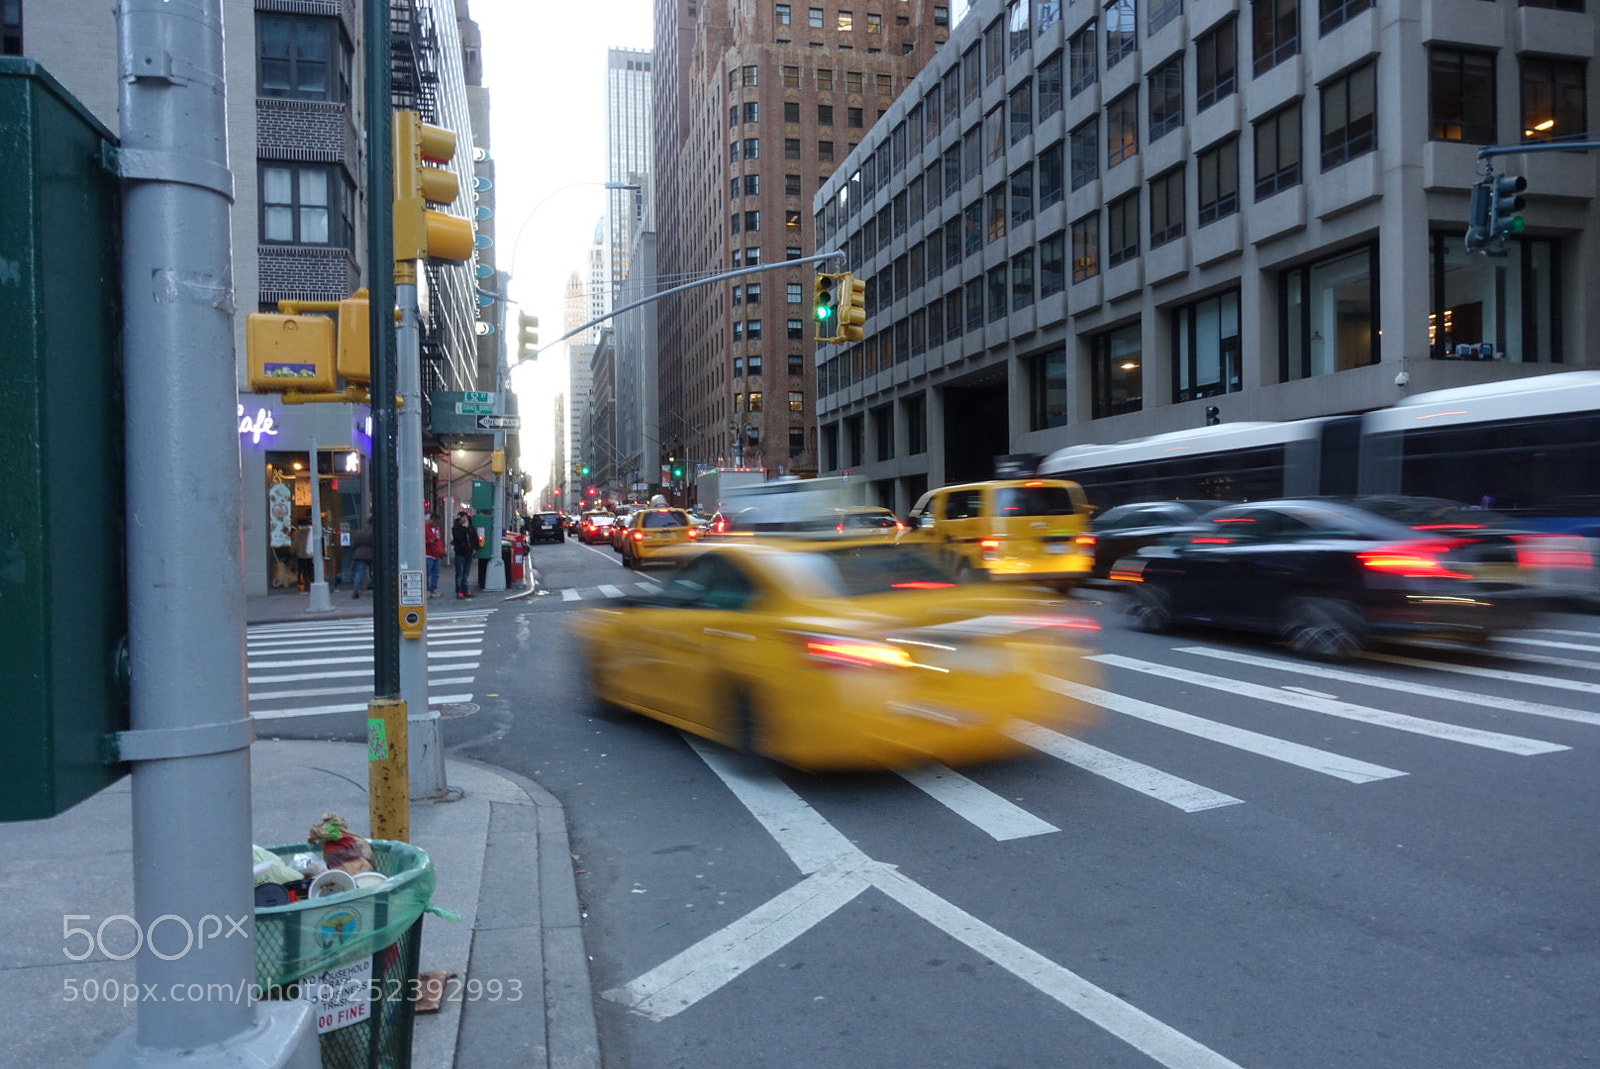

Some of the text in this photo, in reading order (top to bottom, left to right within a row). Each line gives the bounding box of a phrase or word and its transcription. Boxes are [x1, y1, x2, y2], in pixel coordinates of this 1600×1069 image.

[470, 392, 478, 401] 52
[319, 961, 370, 981] HOUSEHOLD
[338, 1003, 366, 1023] FINE
